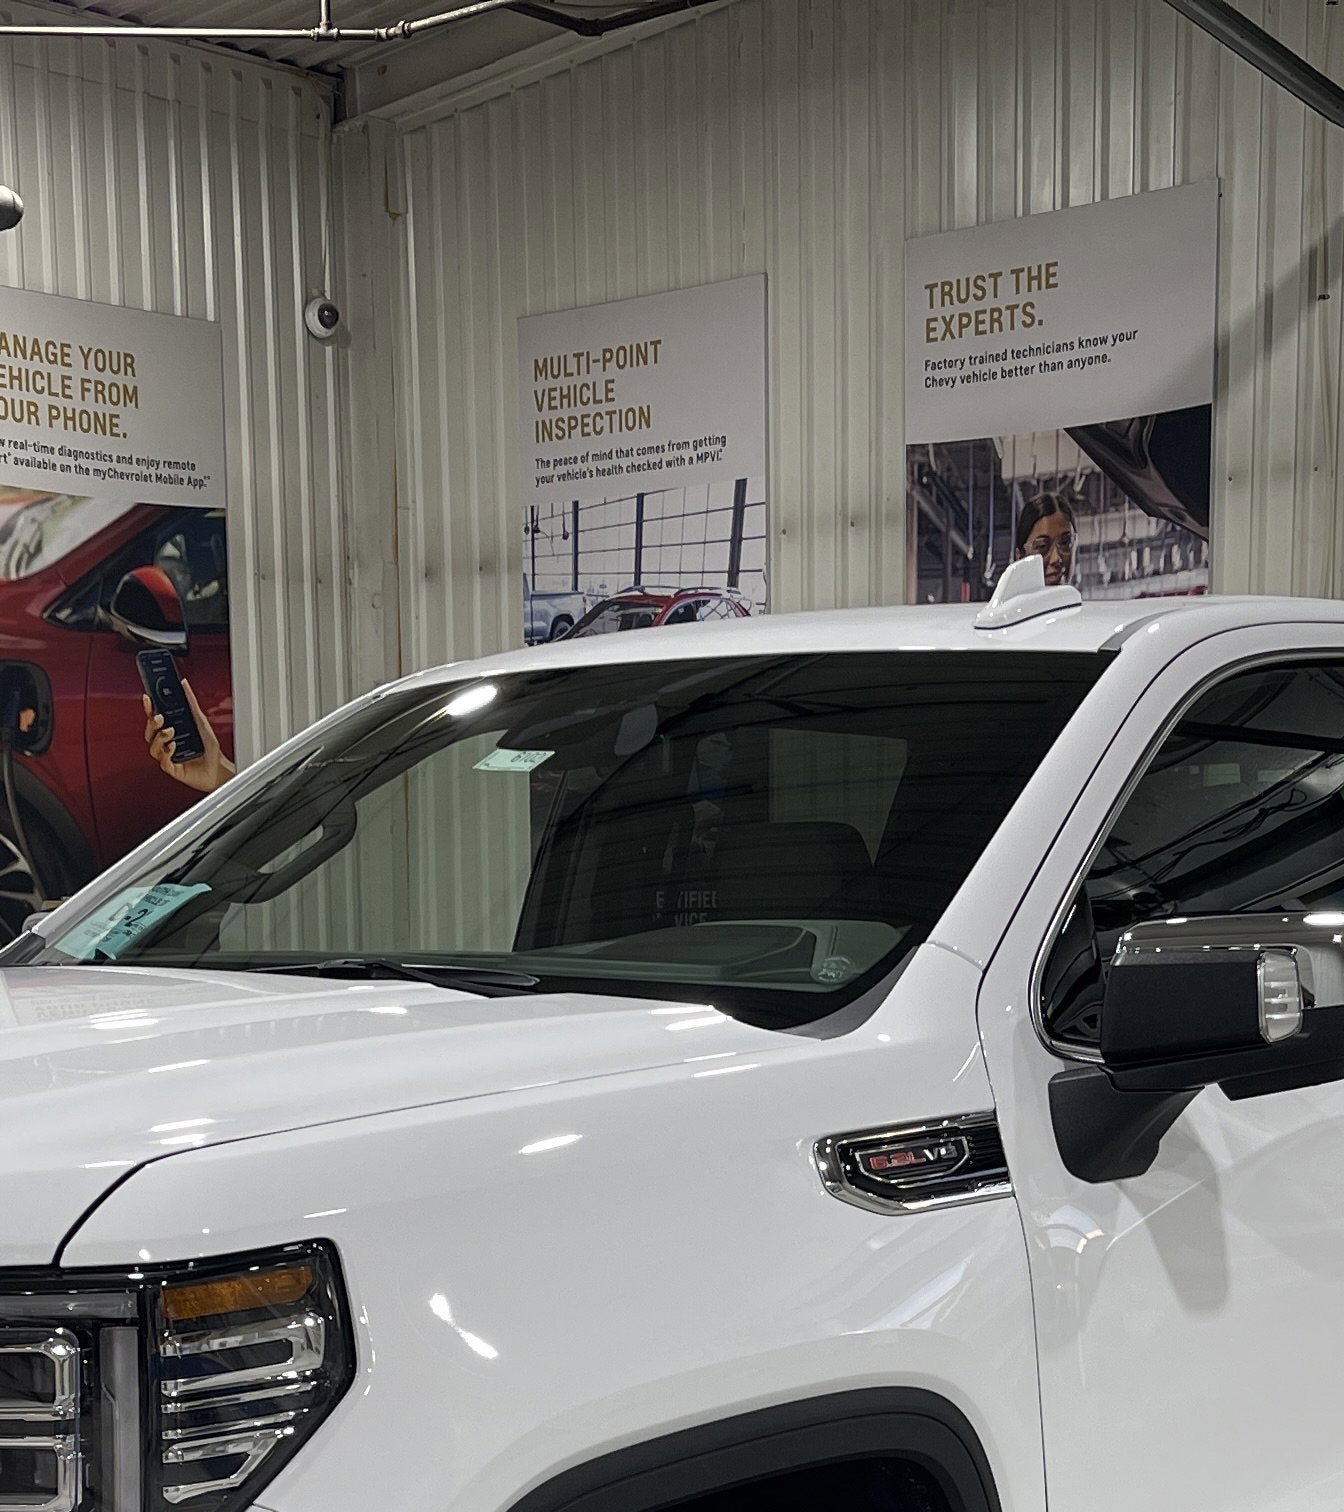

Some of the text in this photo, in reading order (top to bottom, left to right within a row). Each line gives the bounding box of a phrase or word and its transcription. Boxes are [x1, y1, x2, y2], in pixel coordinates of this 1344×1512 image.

[924, 261, 1059, 309] TRUST THE
[925, 301, 1044, 344] EXPERTS.
[78, 345, 137, 378] YOUR
[533, 339, 662, 382] MULTI-POINT
[924, 328, 1139, 371] Factory trained technicians know your
[924, 352, 1112, 389] Chevy vehicle better than anyone.
[80, 377, 139, 409] FROM
[533, 378, 616, 413] VEHICLE
[48, 404, 128, 439] PHONE.
[534, 404, 652, 444] INSPECTION
[8, 438, 55, 456] real-time
[57, 444, 114, 464] diagnostics
[116, 453, 133, 466] and
[135, 456, 161, 471] enjoy
[162, 458, 196, 472] remote
[13, 455, 57, 472] available
[59, 463, 72, 474] on
[73, 463, 91, 476] the
[92, 466, 153, 483] myChevrolet
[155, 472, 185, 486] Mobile
[535, 434, 727, 471] The peace of mind that comes from getting
[535, 473, 555, 488] your
[556, 466, 594, 482] vehicle's
[596, 463, 624, 478] health
[625, 458, 663, 473] checked
[665, 455, 686, 469] with
[688, 457, 694, 466] a
